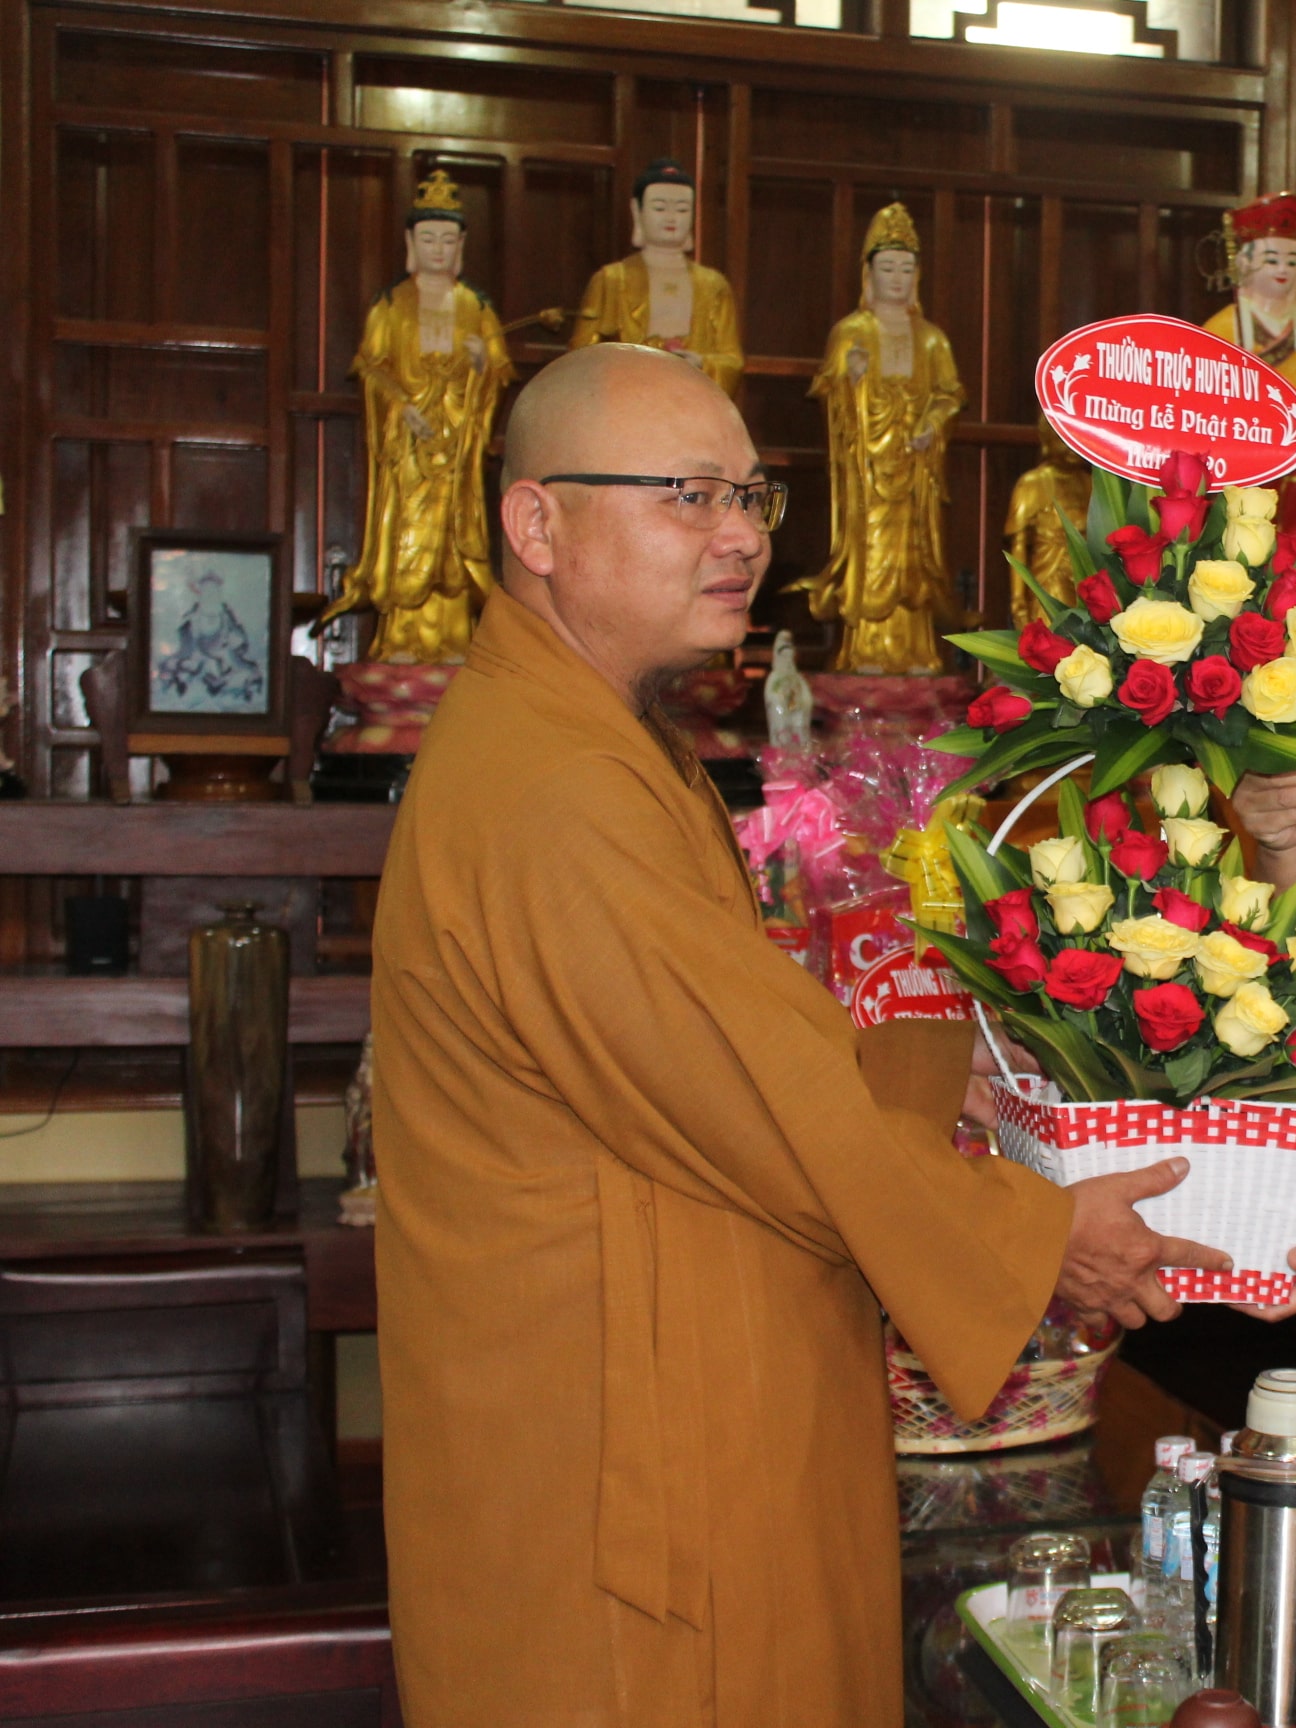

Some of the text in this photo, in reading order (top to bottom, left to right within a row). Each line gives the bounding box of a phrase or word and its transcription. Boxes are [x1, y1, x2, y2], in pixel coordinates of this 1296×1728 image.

[1096, 336, 1259, 404] THƯỜNG TRỰC HUYỆN ỦY
[1085, 395, 1273, 444] Mừng Lễ Phật Đản
